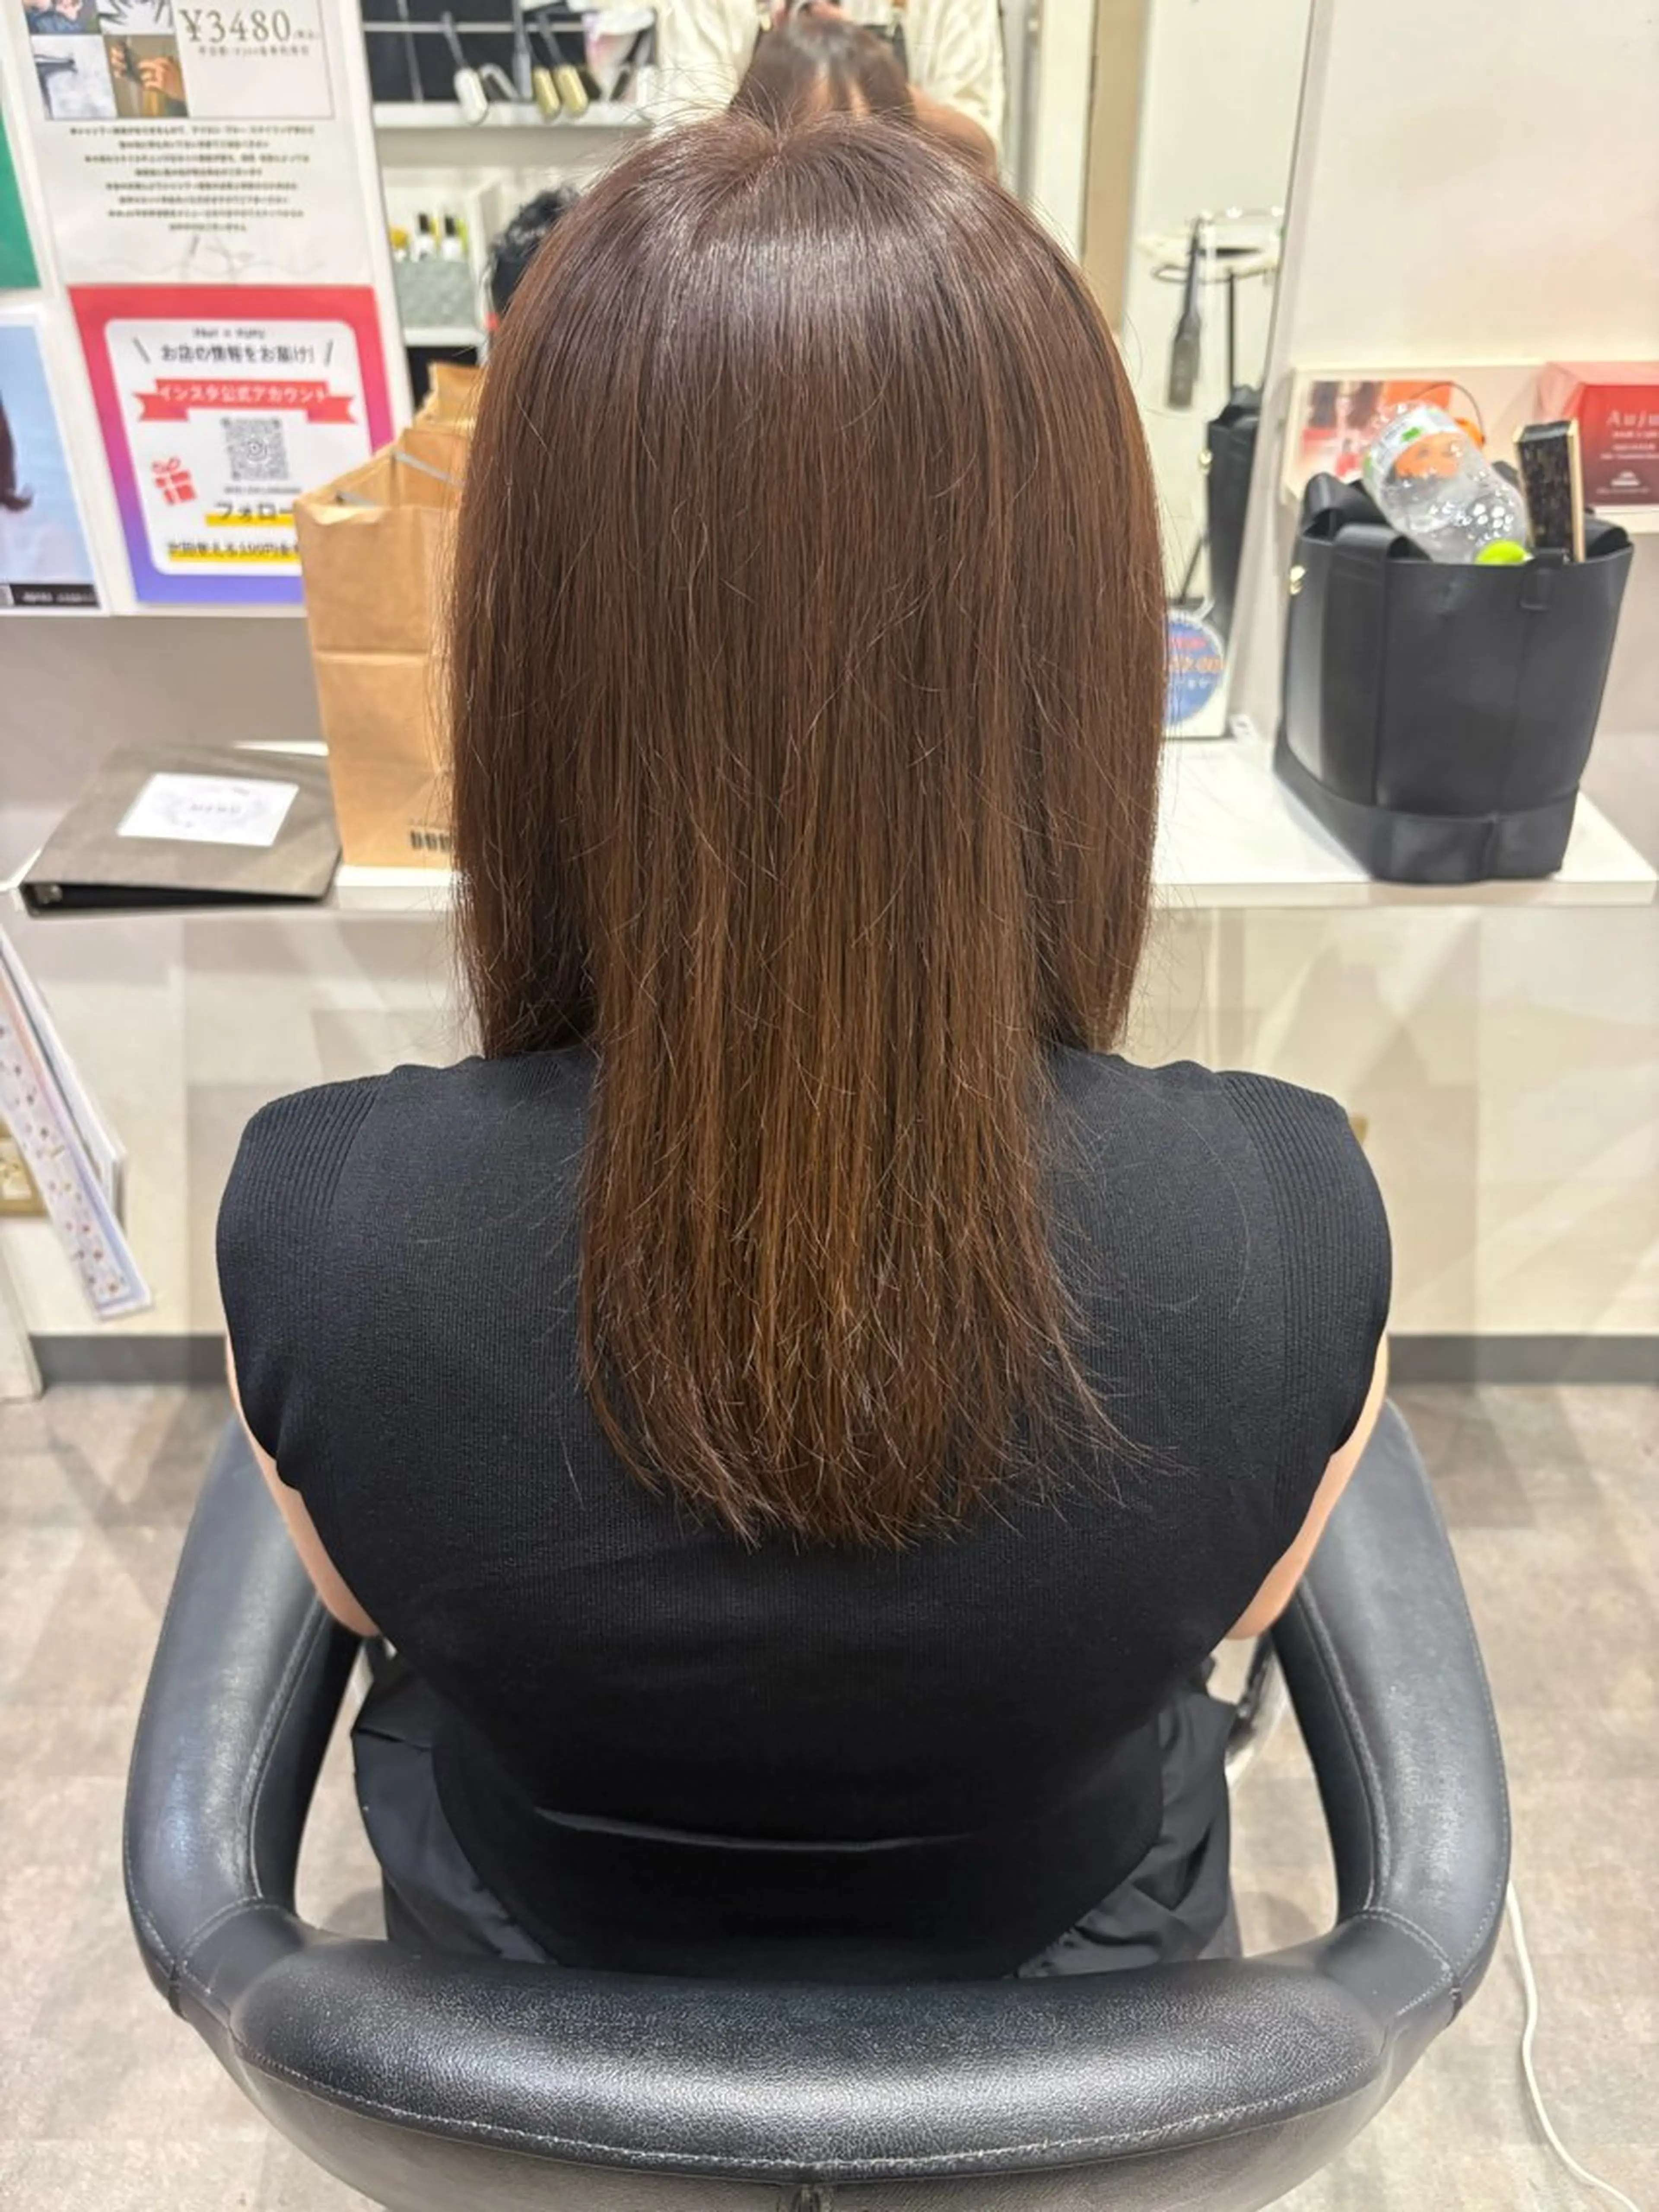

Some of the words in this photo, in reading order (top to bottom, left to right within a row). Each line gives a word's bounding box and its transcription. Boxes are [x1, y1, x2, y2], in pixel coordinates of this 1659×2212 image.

[178, 9, 291, 43] ¥3480
[159, 384, 327, 404] インスタ公式アカウント
